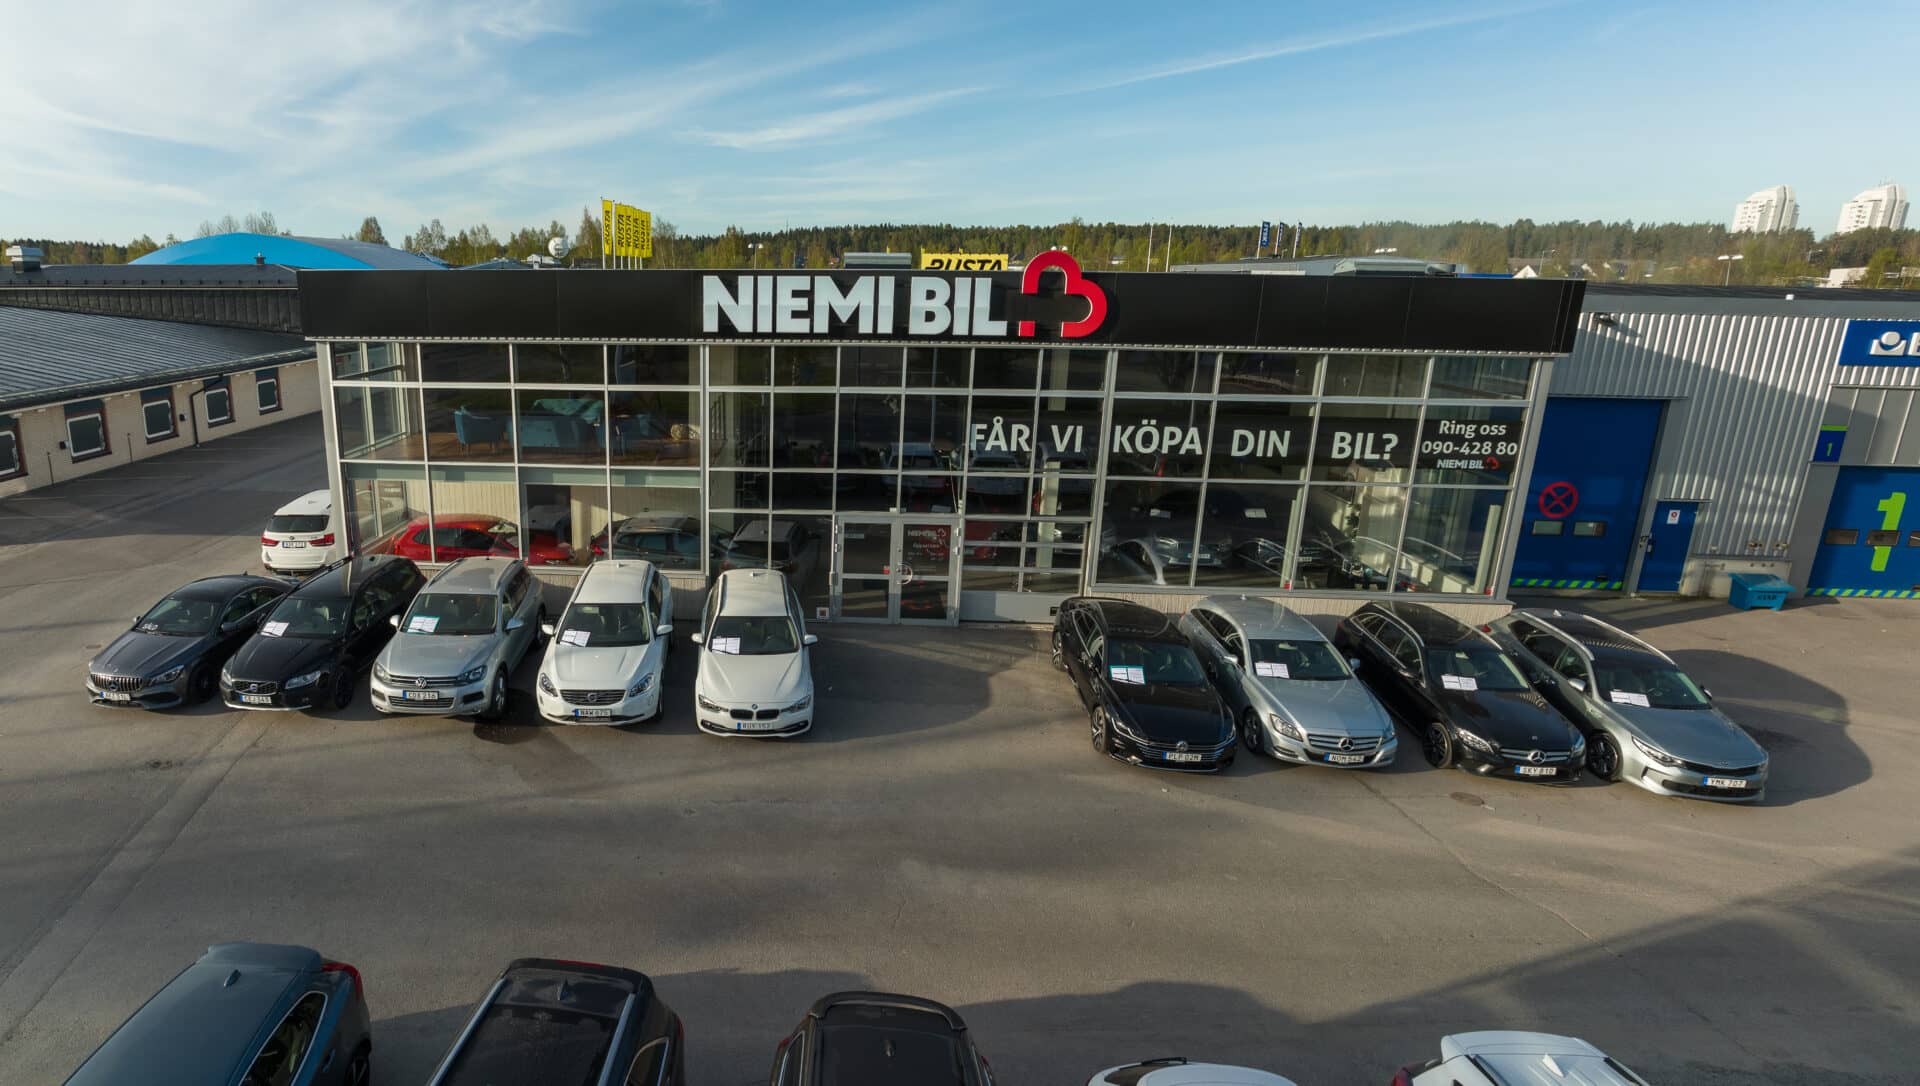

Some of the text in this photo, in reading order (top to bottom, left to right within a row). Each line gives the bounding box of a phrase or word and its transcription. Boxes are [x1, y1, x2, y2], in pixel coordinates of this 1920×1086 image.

[617, 214, 625, 248] RUSTA
[702, 274, 1009, 337] NIEMI BIL
[970, 416, 1399, 461] FÅR VI KÖPA DIN BIL?
[1439, 420, 1507, 439] Ring oss
[1421, 440, 1518, 456] 090-428 80
[1436, 458, 1485, 470] NIEMI BIL
[1870, 491, 1907, 572] 1
